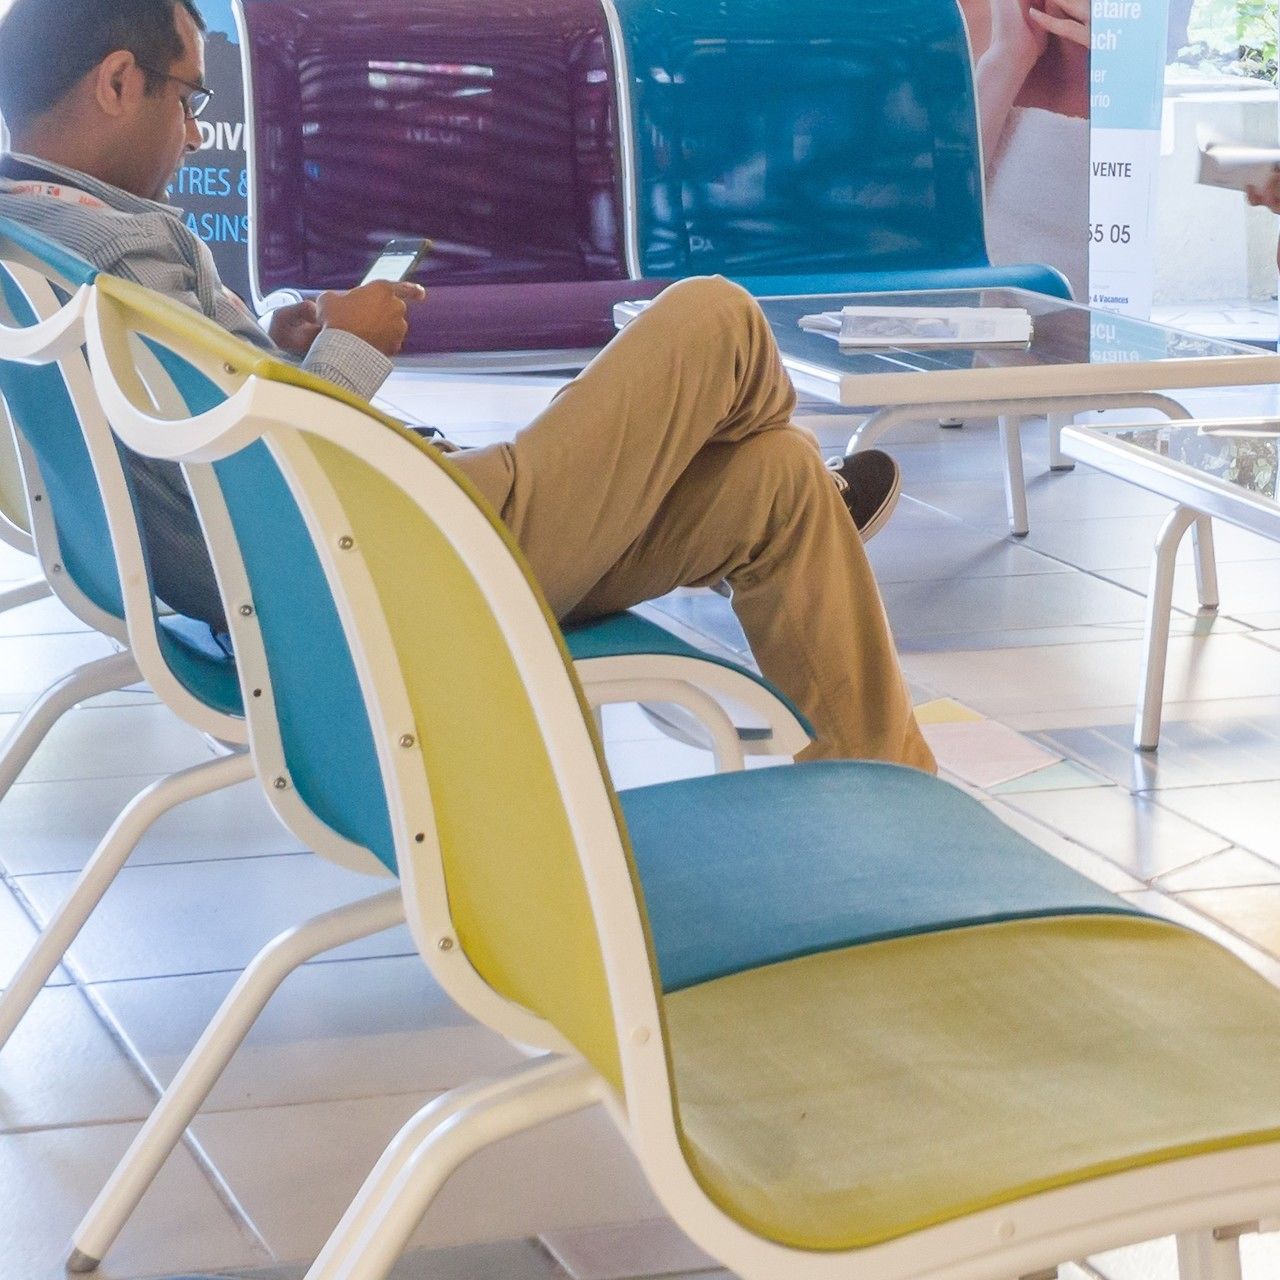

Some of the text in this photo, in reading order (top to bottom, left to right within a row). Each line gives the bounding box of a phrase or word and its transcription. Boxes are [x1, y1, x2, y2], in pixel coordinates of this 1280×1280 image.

[1092, 161, 1132, 178] VENTE
[1110, 223, 1131, 245] 05
[1099, 294, 1129, 305] Vacances
